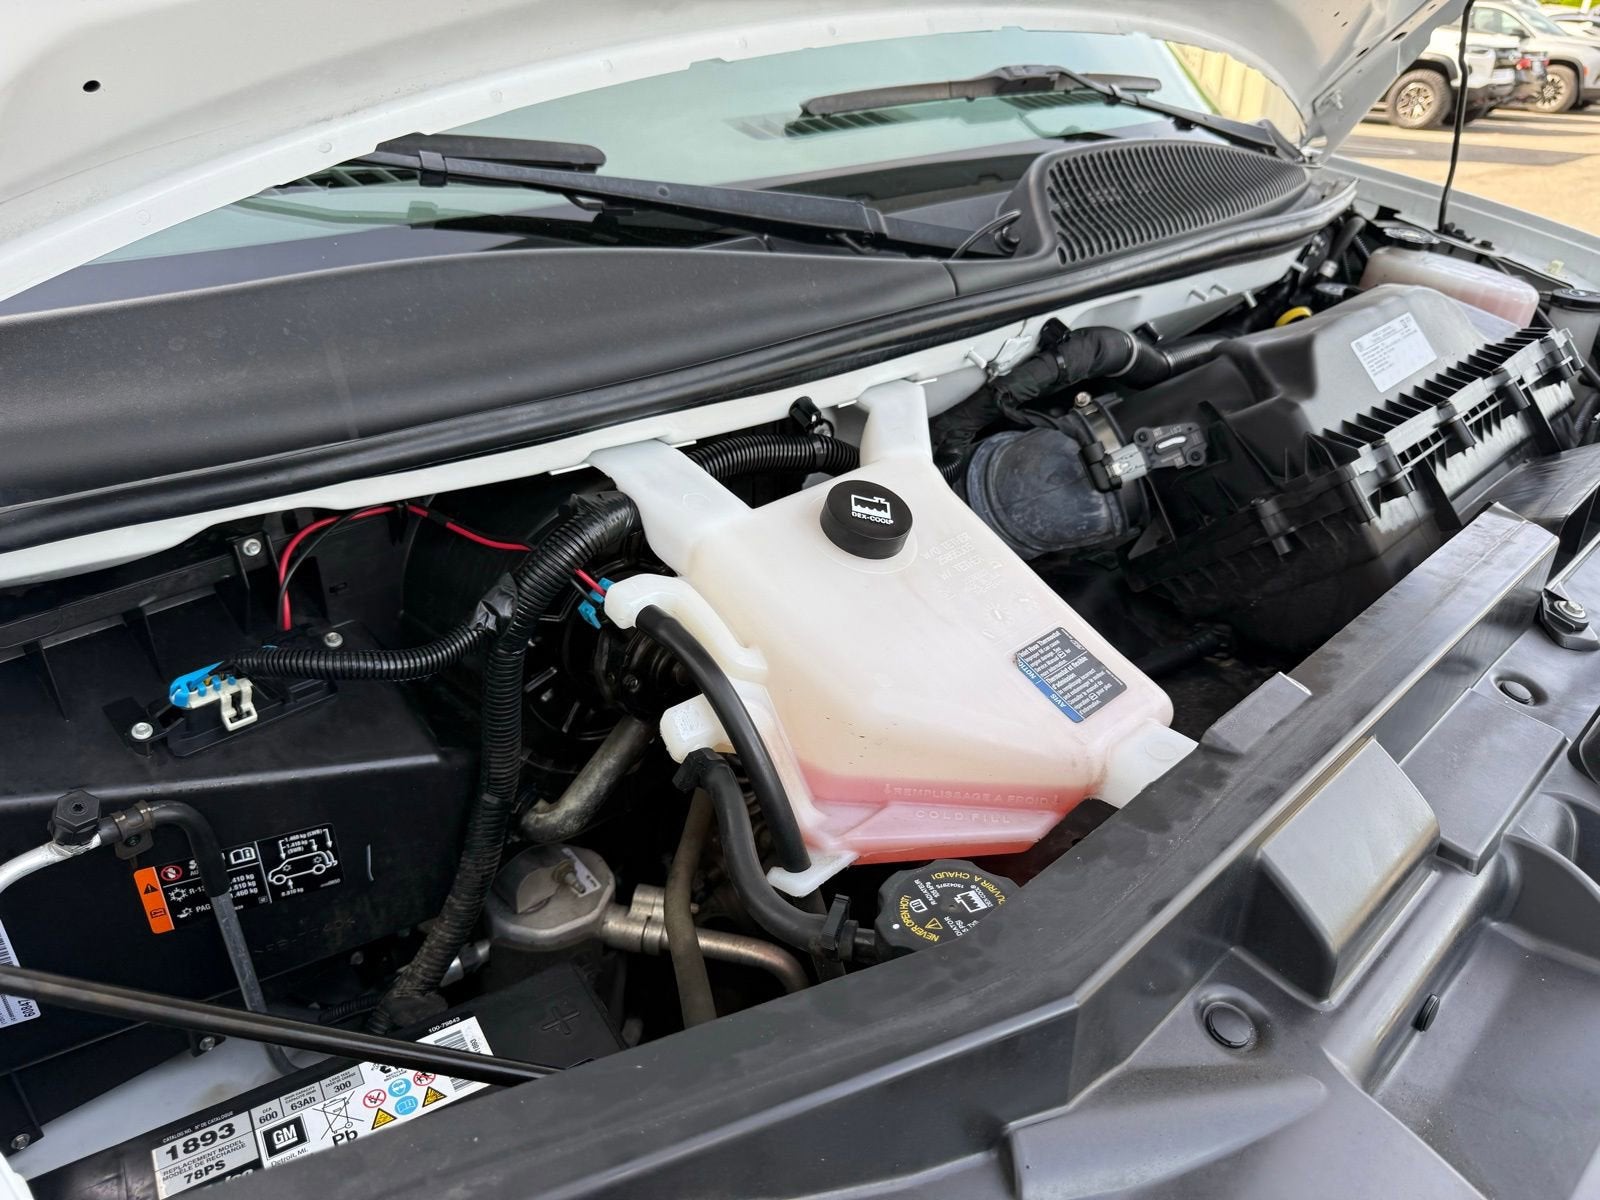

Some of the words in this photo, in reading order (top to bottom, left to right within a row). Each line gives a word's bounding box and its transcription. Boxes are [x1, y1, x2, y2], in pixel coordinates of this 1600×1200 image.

[1018, 661, 1036, 680] NOTIC
[1050, 693, 1066, 708] AVIS
[892, 786, 990, 800] REMPLISSAGE
[1008, 794, 1048, 805] FROID
[915, 810, 964, 821] COLD
[972, 812, 1010, 824] FILL
[245, 872, 254, 880] kg
[246, 879, 256, 887] kg
[248, 886, 258, 894] kg
[196, 904, 212, 913] PAG
[900, 908, 914, 928] OPEN
[943, 916, 963, 936] DIATOR
[910, 924, 940, 942] NEVER
[334, 1080, 352, 1093] 300
[290, 1095, 316, 1112] 63Ah
[259, 1111, 278, 1124] 600
[166, 1122, 236, 1161] 1893
[272, 1124, 298, 1146] GM
[332, 1130, 358, 1146] Pb
[163, 1150, 217, 1176] REPLACEMENT
[218, 1139, 244, 1154] MODEL
[194, 1160, 205, 1168] DE
[205, 1142, 248, 1164] RECHANGE
[184, 1160, 226, 1184] 78PS
